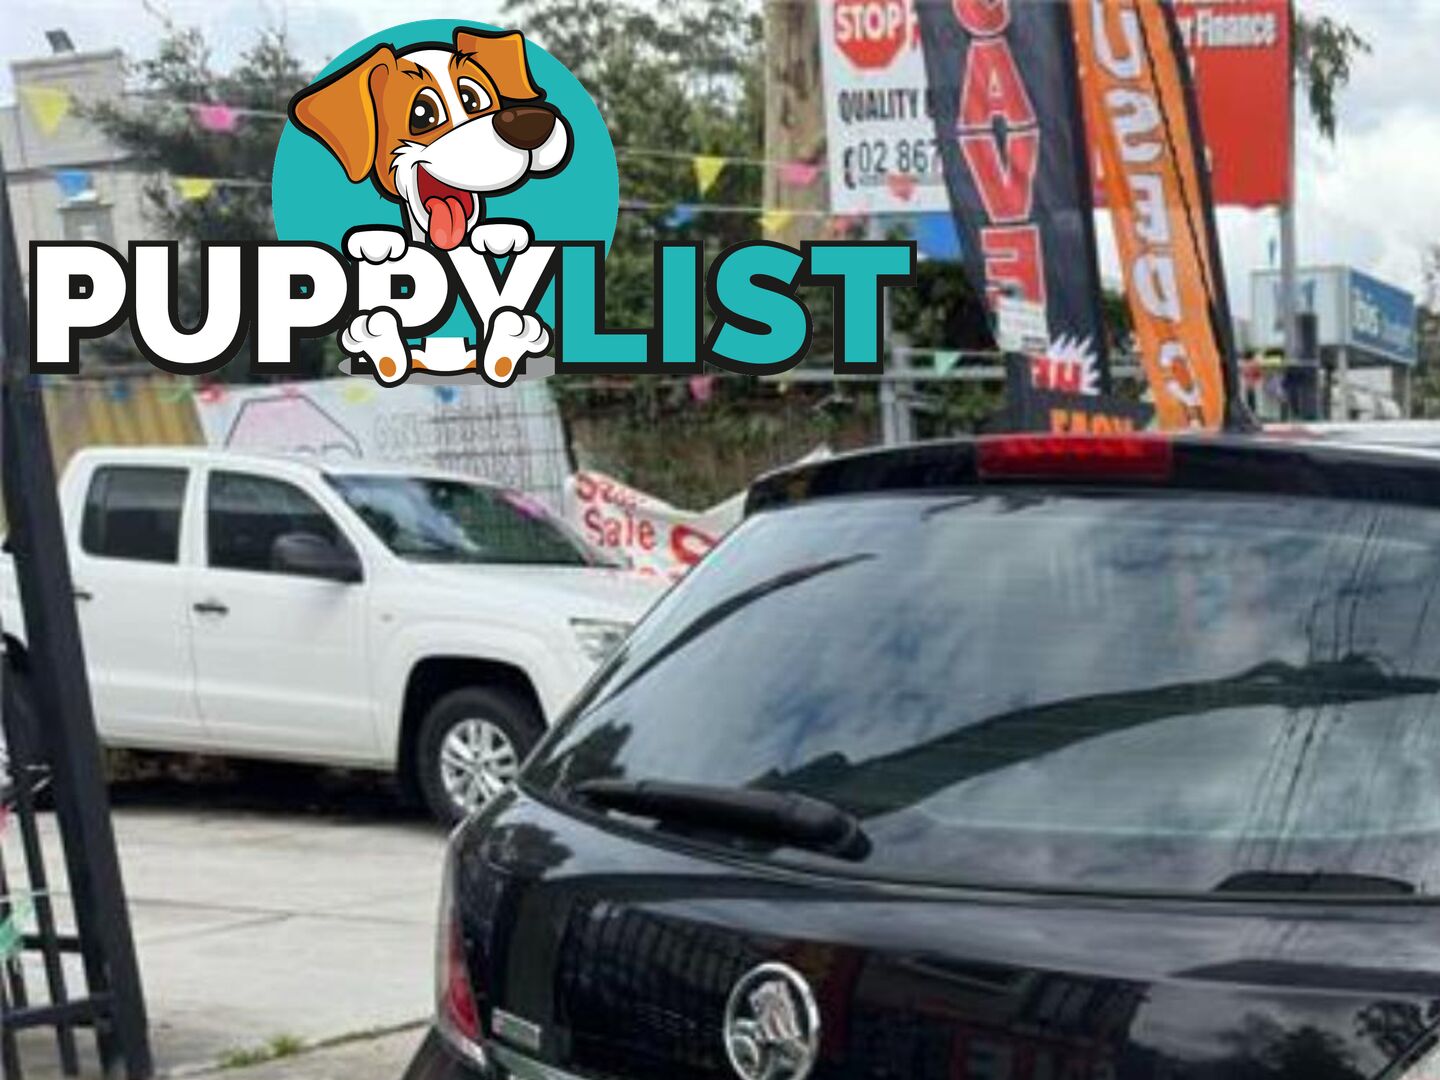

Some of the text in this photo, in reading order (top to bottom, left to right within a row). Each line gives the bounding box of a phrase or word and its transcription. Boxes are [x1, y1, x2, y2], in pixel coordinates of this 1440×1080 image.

[835, 1, 904, 43] STOP
[838, 88, 919, 123] QUALITY
[859, 140, 888, 173] 02
[584, 507, 656, 550] Sale
